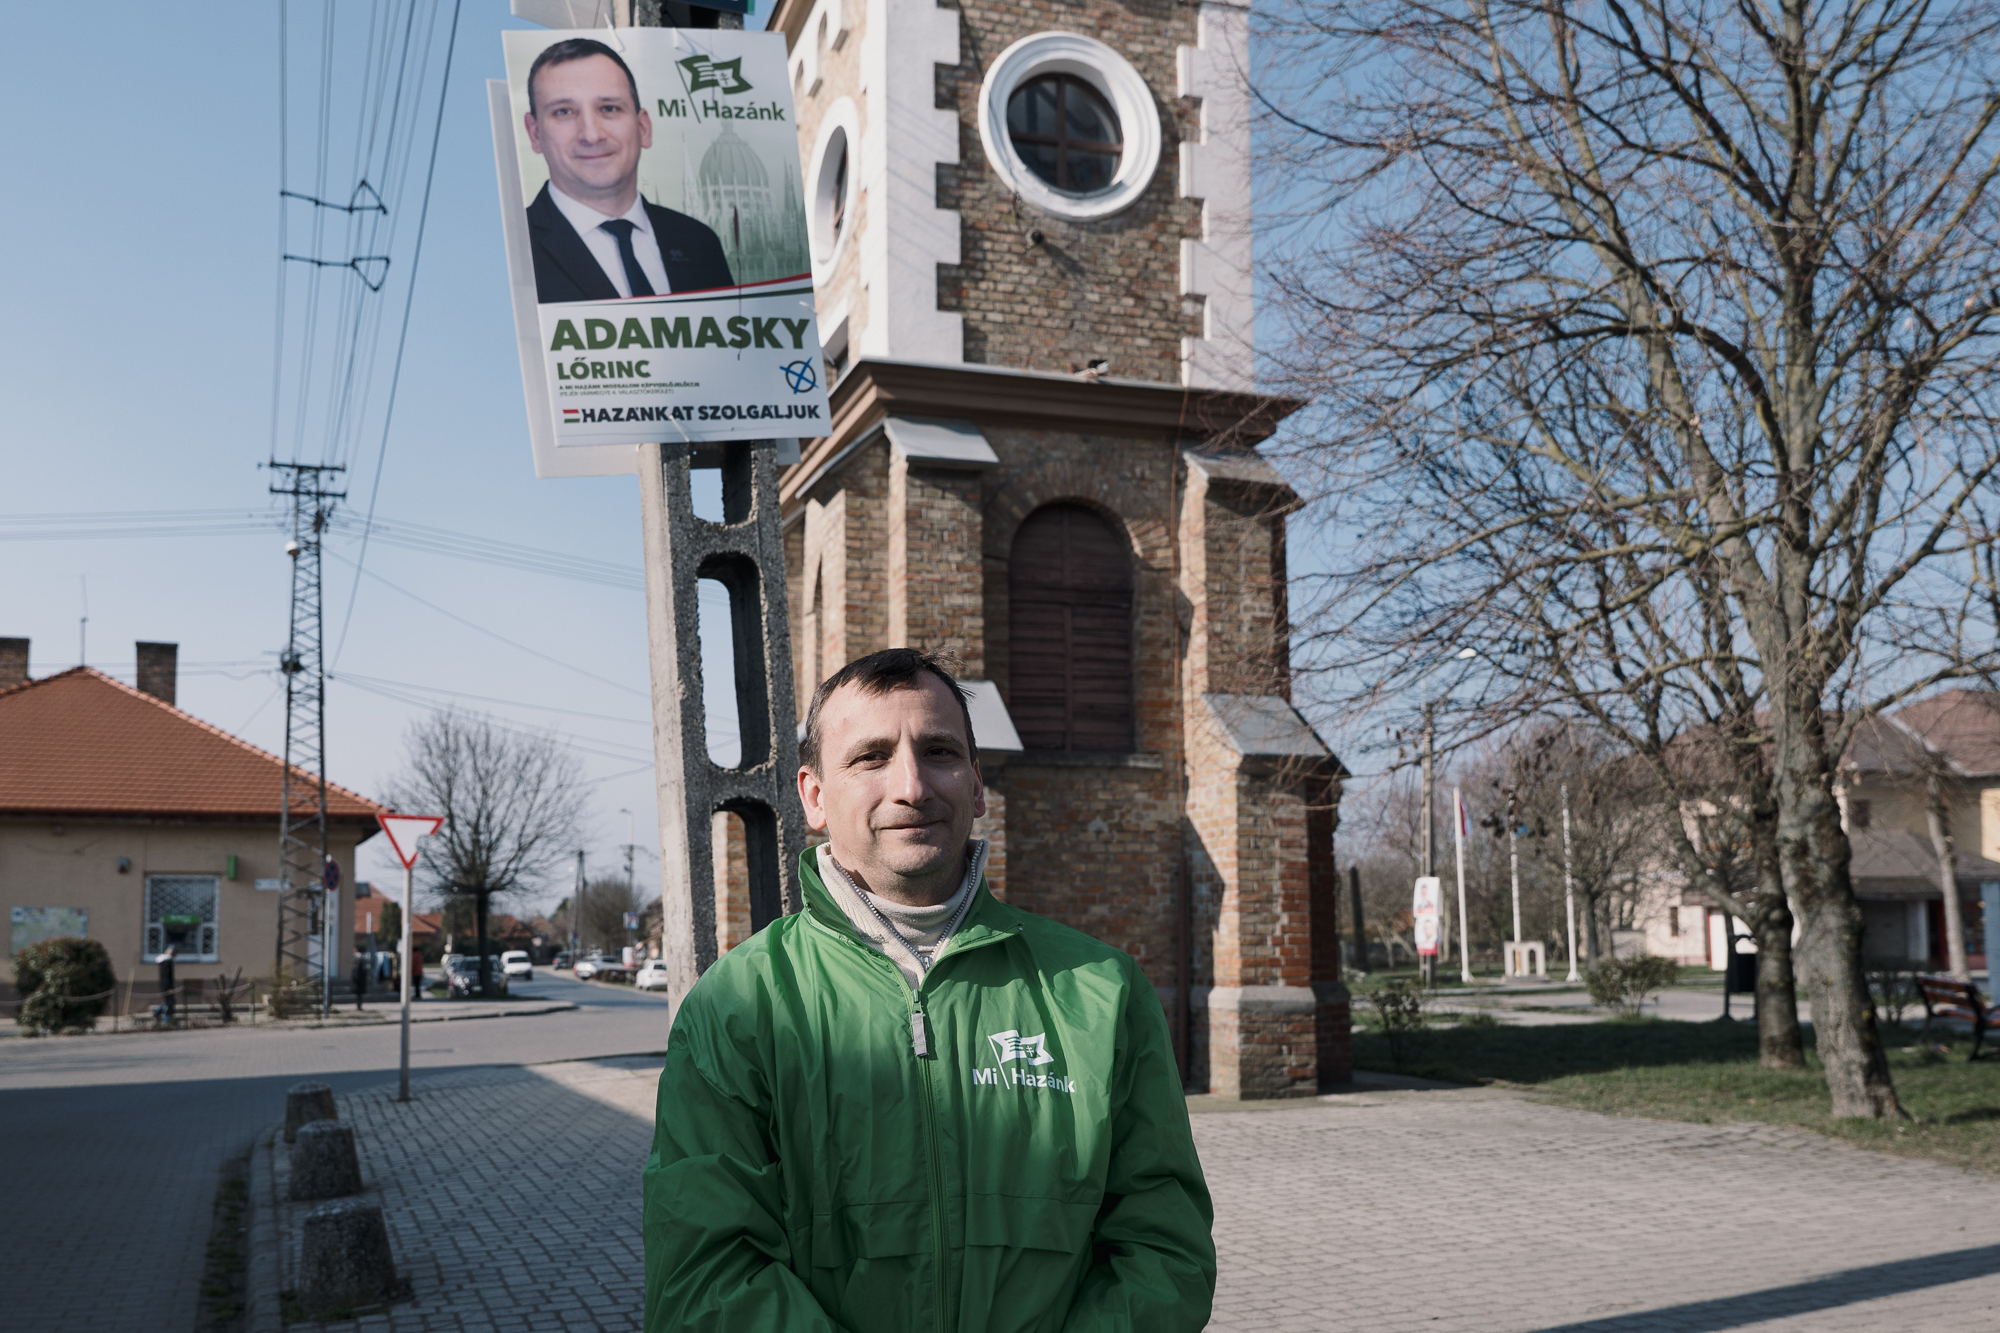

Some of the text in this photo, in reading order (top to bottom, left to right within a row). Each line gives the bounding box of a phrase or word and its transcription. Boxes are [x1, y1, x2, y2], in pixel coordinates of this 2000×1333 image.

[657, 99, 786, 121] Mi Hazánk
[550, 316, 810, 351] ADAMASKY
[557, 356, 652, 380] LŐRINC
[582, 404, 820, 423] HAZÁNKAT SZOLGÁLJUK
[972, 1067, 1076, 1094] Mi Hazánk
